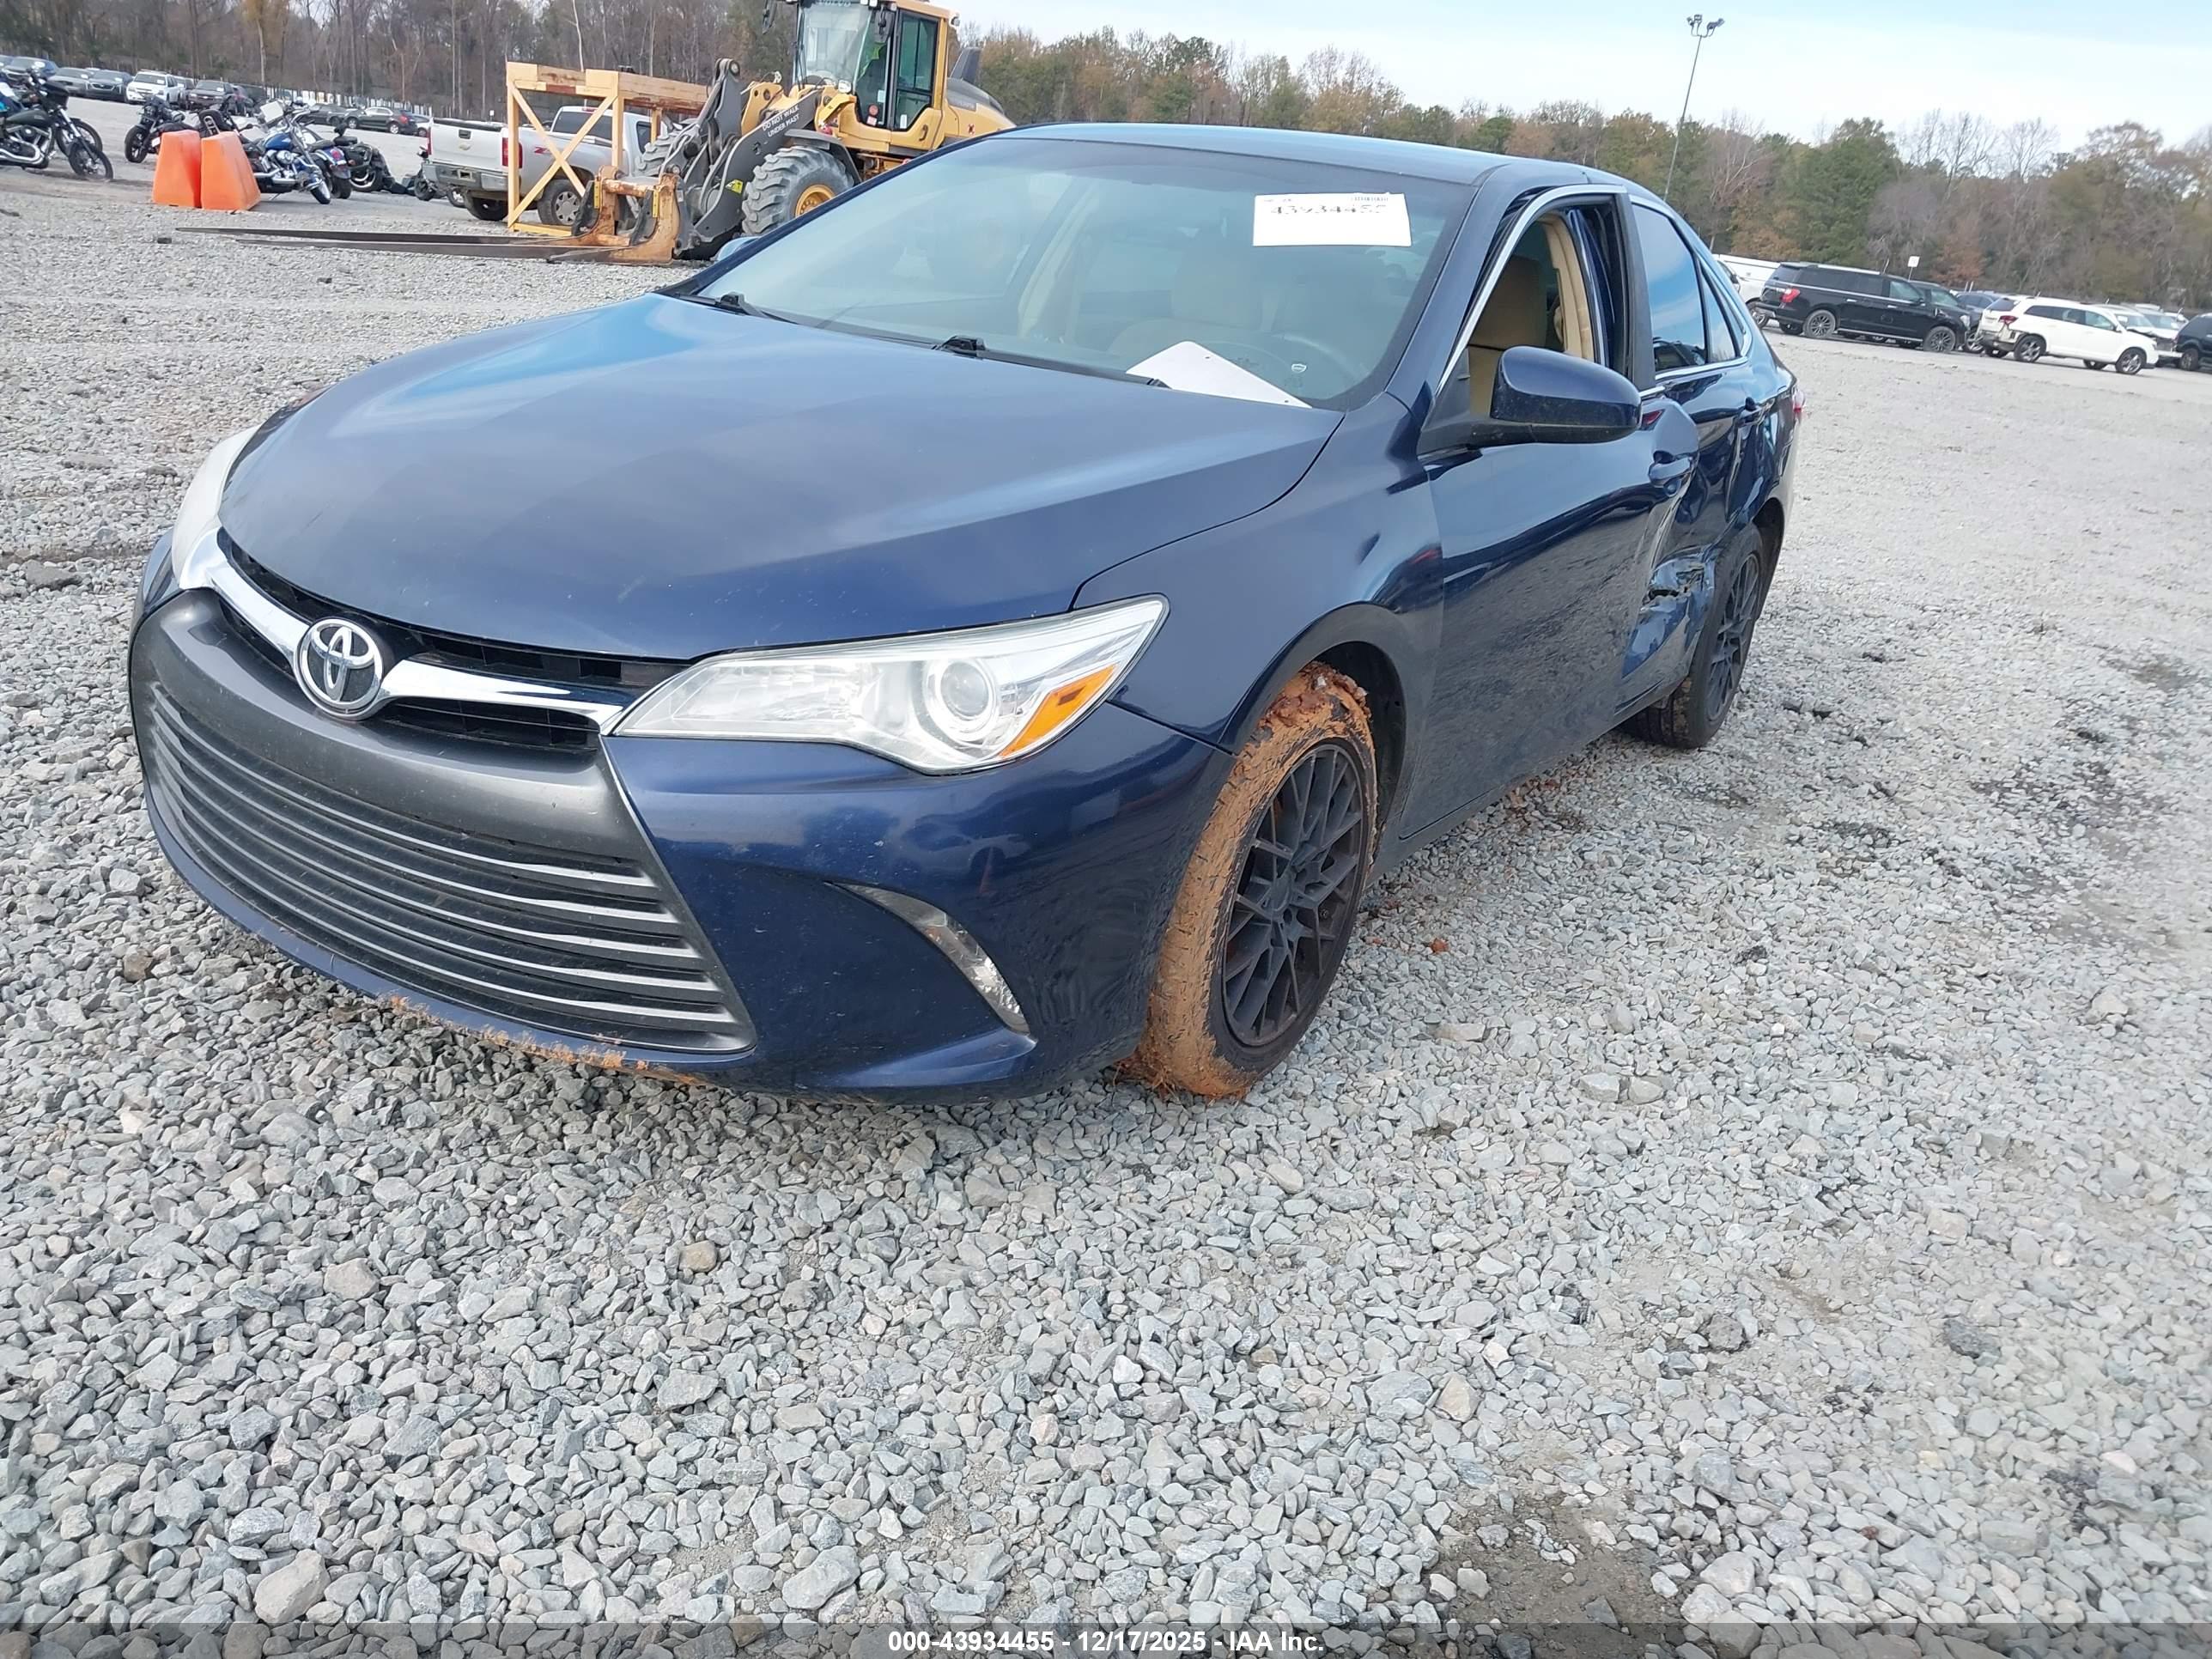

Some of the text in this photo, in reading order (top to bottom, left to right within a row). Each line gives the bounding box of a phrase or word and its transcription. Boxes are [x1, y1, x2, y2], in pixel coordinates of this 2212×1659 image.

[763, 105, 799, 131] DO NOT WALK
[768, 113, 799, 137] UNDER MAST
